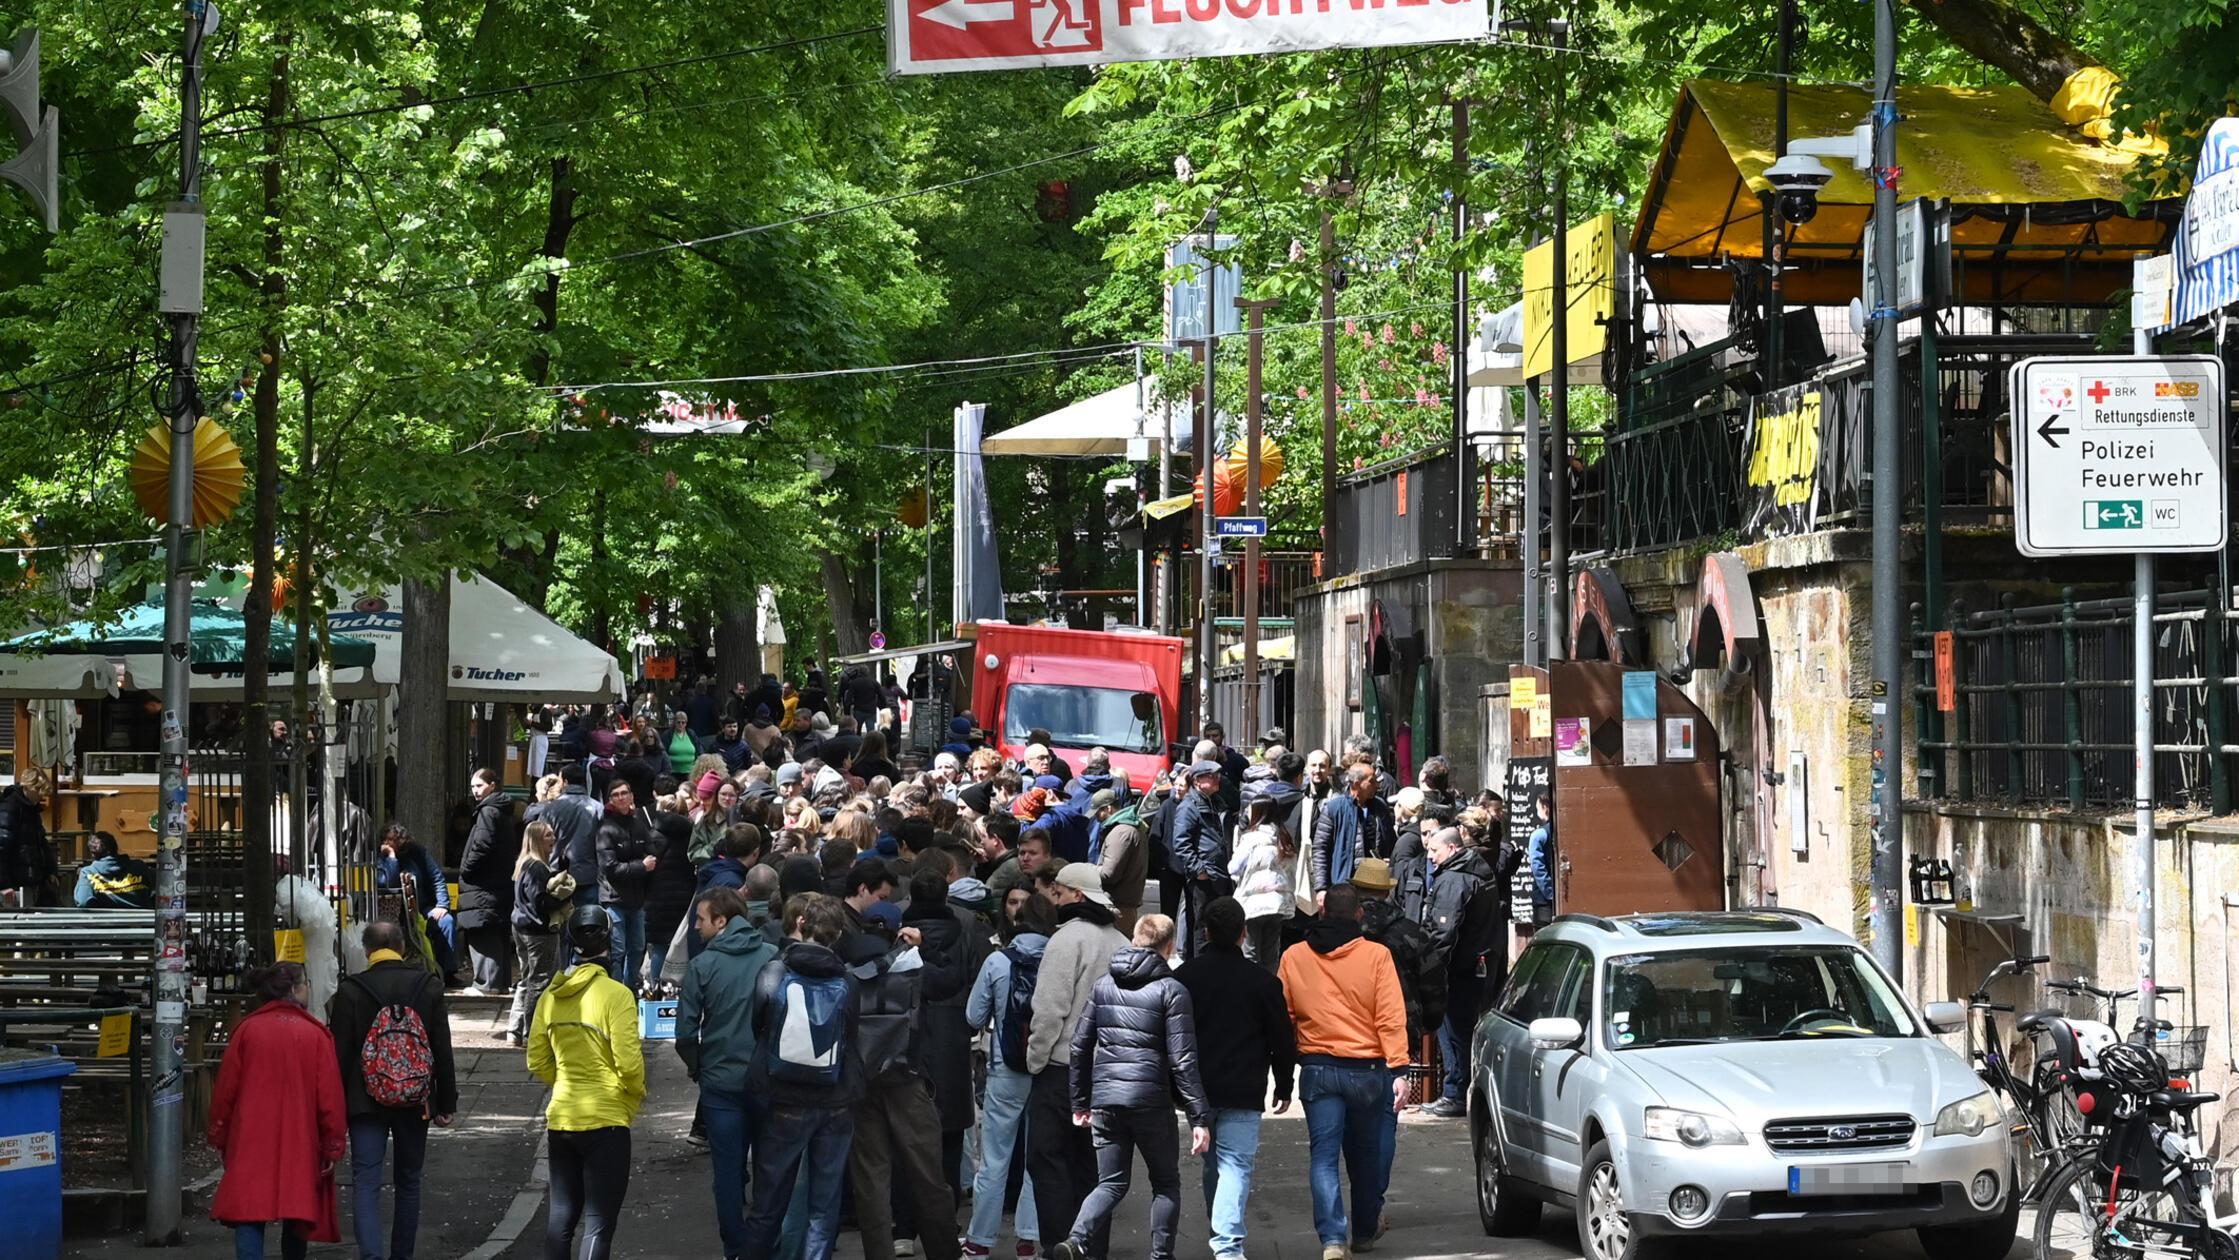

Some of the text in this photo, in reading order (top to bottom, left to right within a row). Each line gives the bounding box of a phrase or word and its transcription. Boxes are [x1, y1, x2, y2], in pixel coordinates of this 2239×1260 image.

[2115, 387, 2137, 397] BRK
[2095, 408, 2195, 427] Rettungsdienste
[2082, 440, 2154, 459] Polizei
[2082, 468, 2203, 488] Feuerwehr
[2155, 508, 2176, 520] WC
[1223, 522, 1258, 534] Pfaffweg
[328, 614, 402, 629] uche
[467, 667, 526, 681] Tucher
